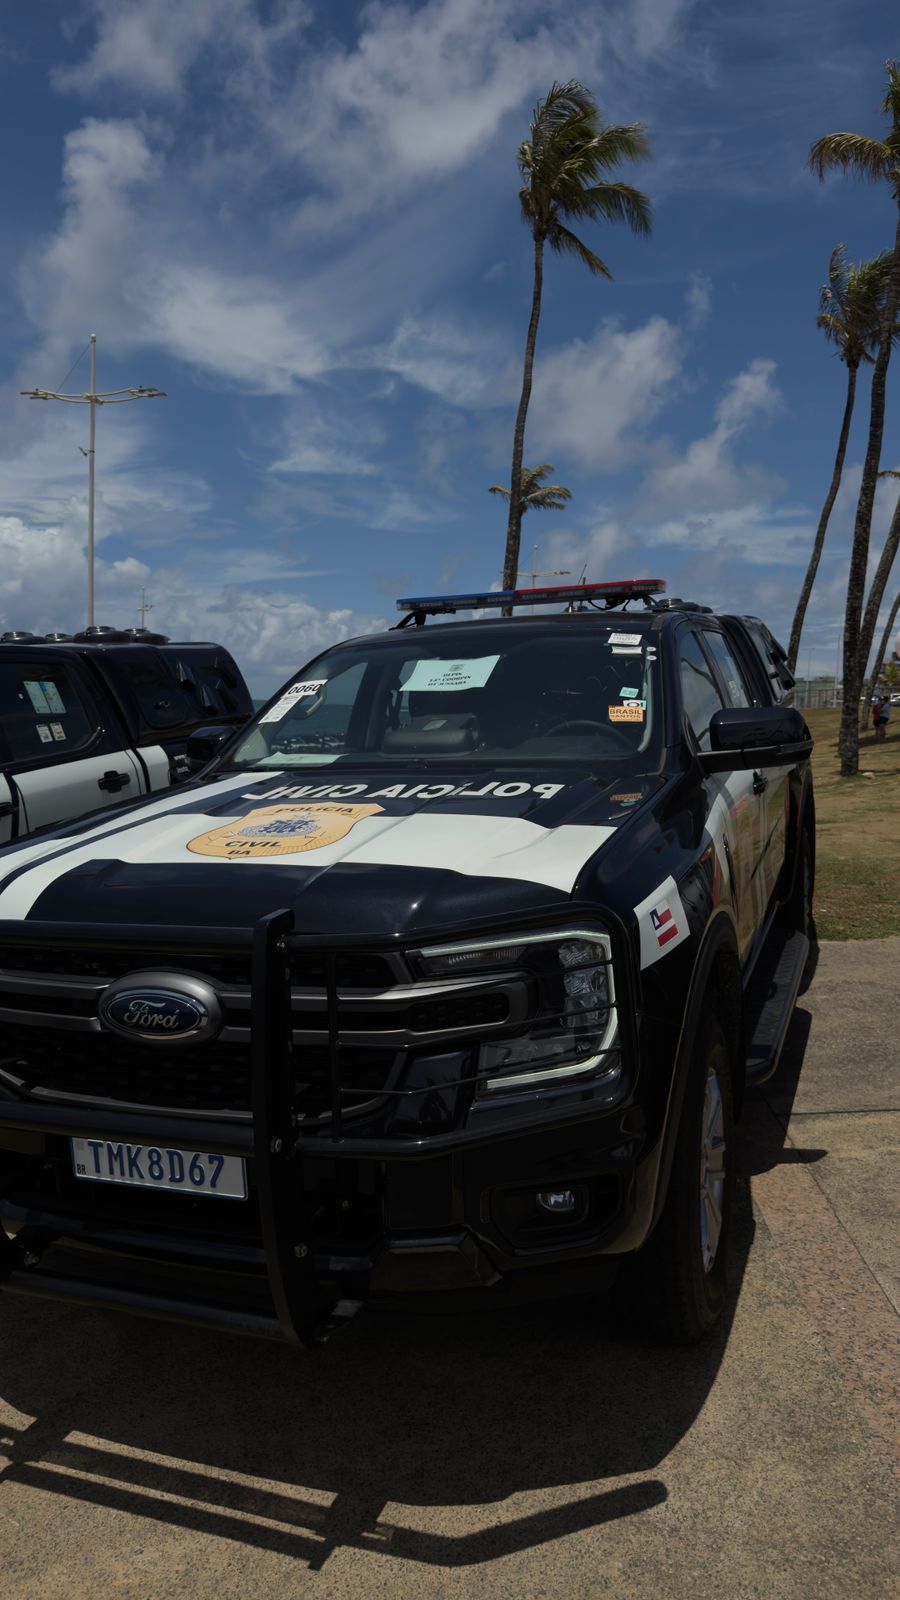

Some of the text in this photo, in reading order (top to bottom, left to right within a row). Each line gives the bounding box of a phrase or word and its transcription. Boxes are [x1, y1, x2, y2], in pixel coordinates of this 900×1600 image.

[288, 683, 323, 695] 0060
[224, 840, 281, 848] CIVIL
[123, 999, 181, 1028] Ford
[76, 1163, 87, 1175] BR
[87, 1140, 225, 1188] TMK8D67
